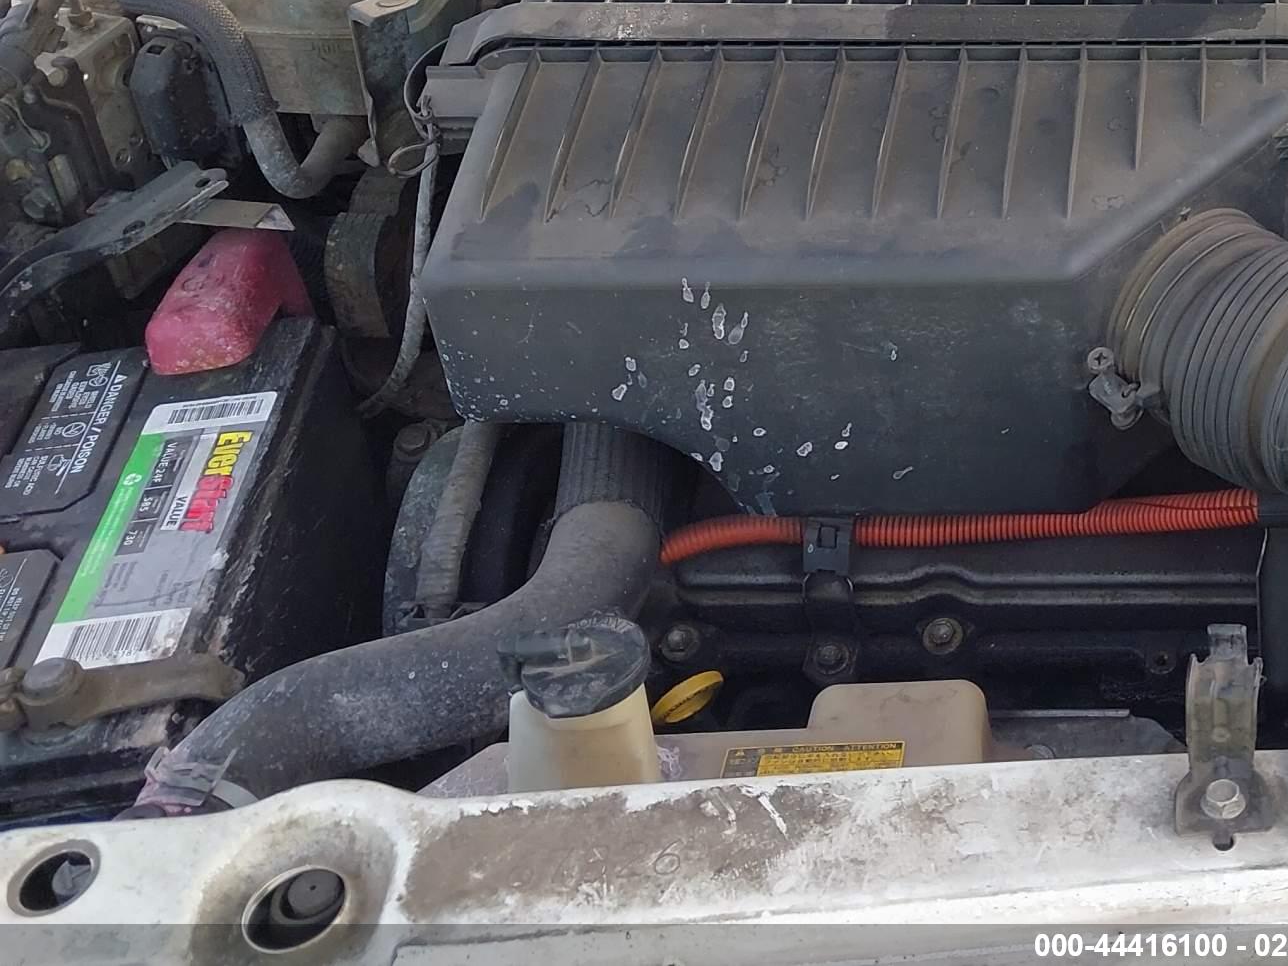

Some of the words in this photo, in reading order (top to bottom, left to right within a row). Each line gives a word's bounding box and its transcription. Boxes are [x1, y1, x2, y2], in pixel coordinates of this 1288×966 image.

[93, 384, 122, 425] DANGER
[70, 434, 99, 474] POISON
[165, 495, 189, 527] VALUE
